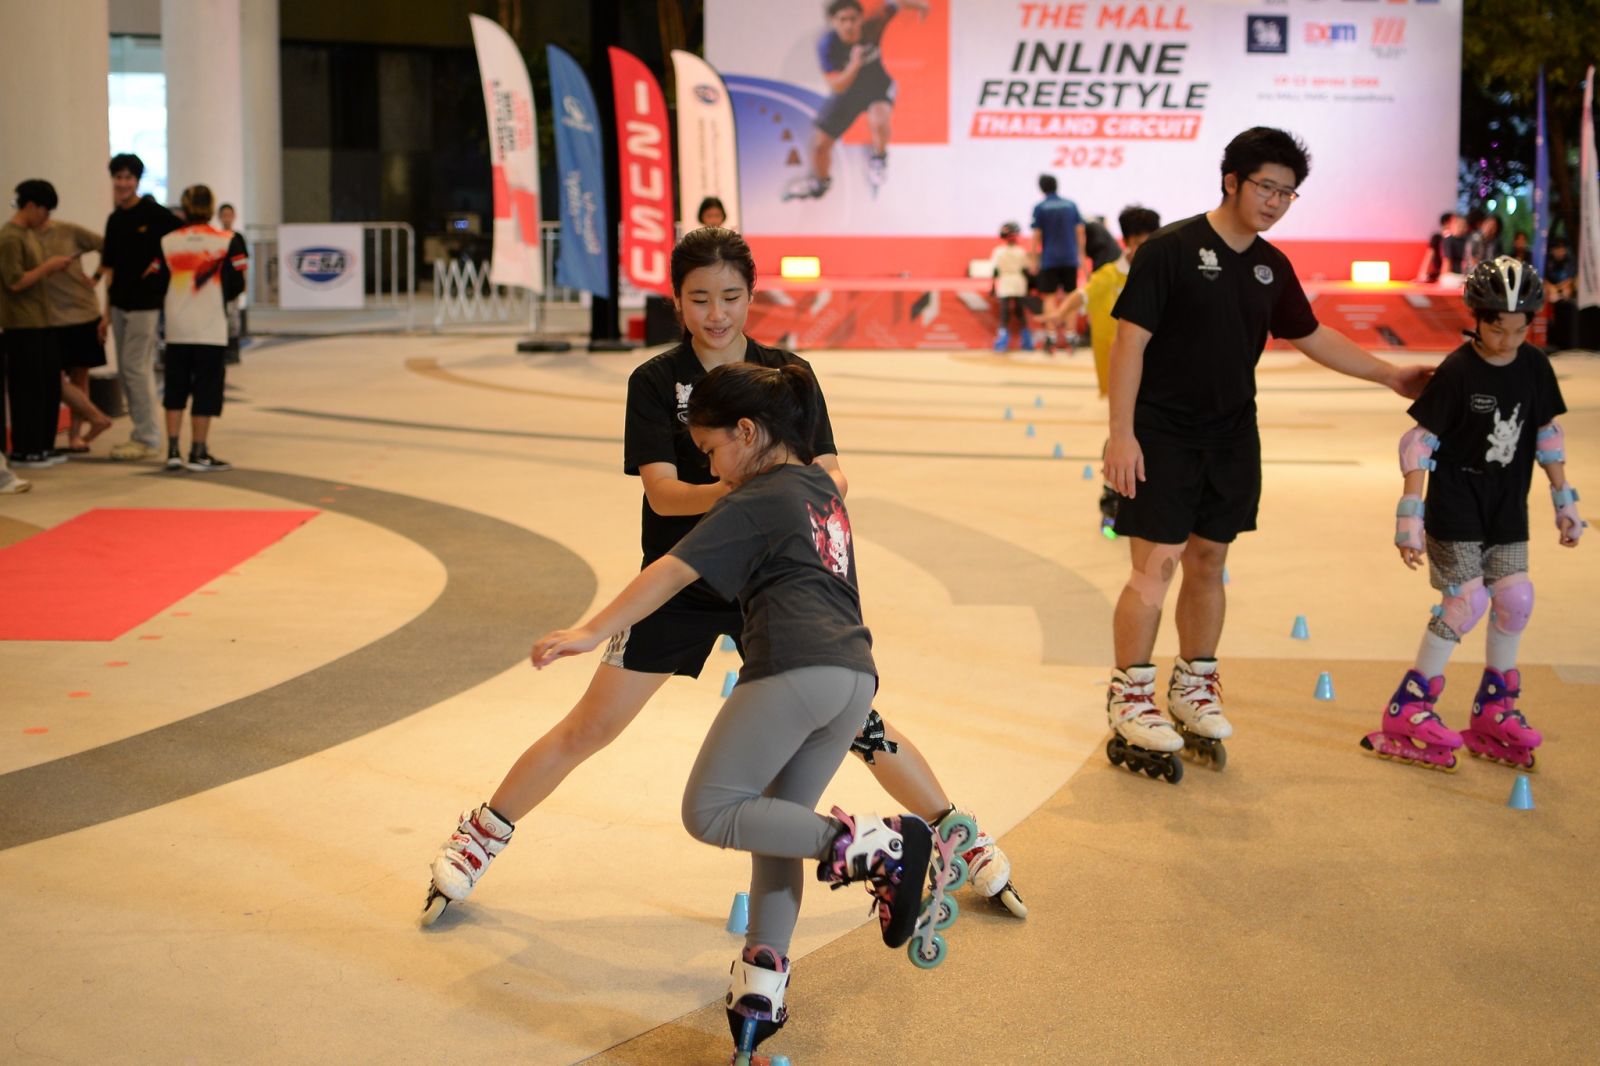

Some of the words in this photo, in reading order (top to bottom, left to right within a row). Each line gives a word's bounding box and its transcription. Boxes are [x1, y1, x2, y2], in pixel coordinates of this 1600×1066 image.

[1019, 3, 1087, 29] THE
[1096, 4, 1193, 30] MALL
[1011, 41, 1188, 75] INLINE
[978, 80, 1210, 109] FREESTYLE
[977, 115, 1099, 136] THAILAND
[1102, 117, 1198, 138] CIRCUIT
[1051, 145, 1125, 168] 2025
